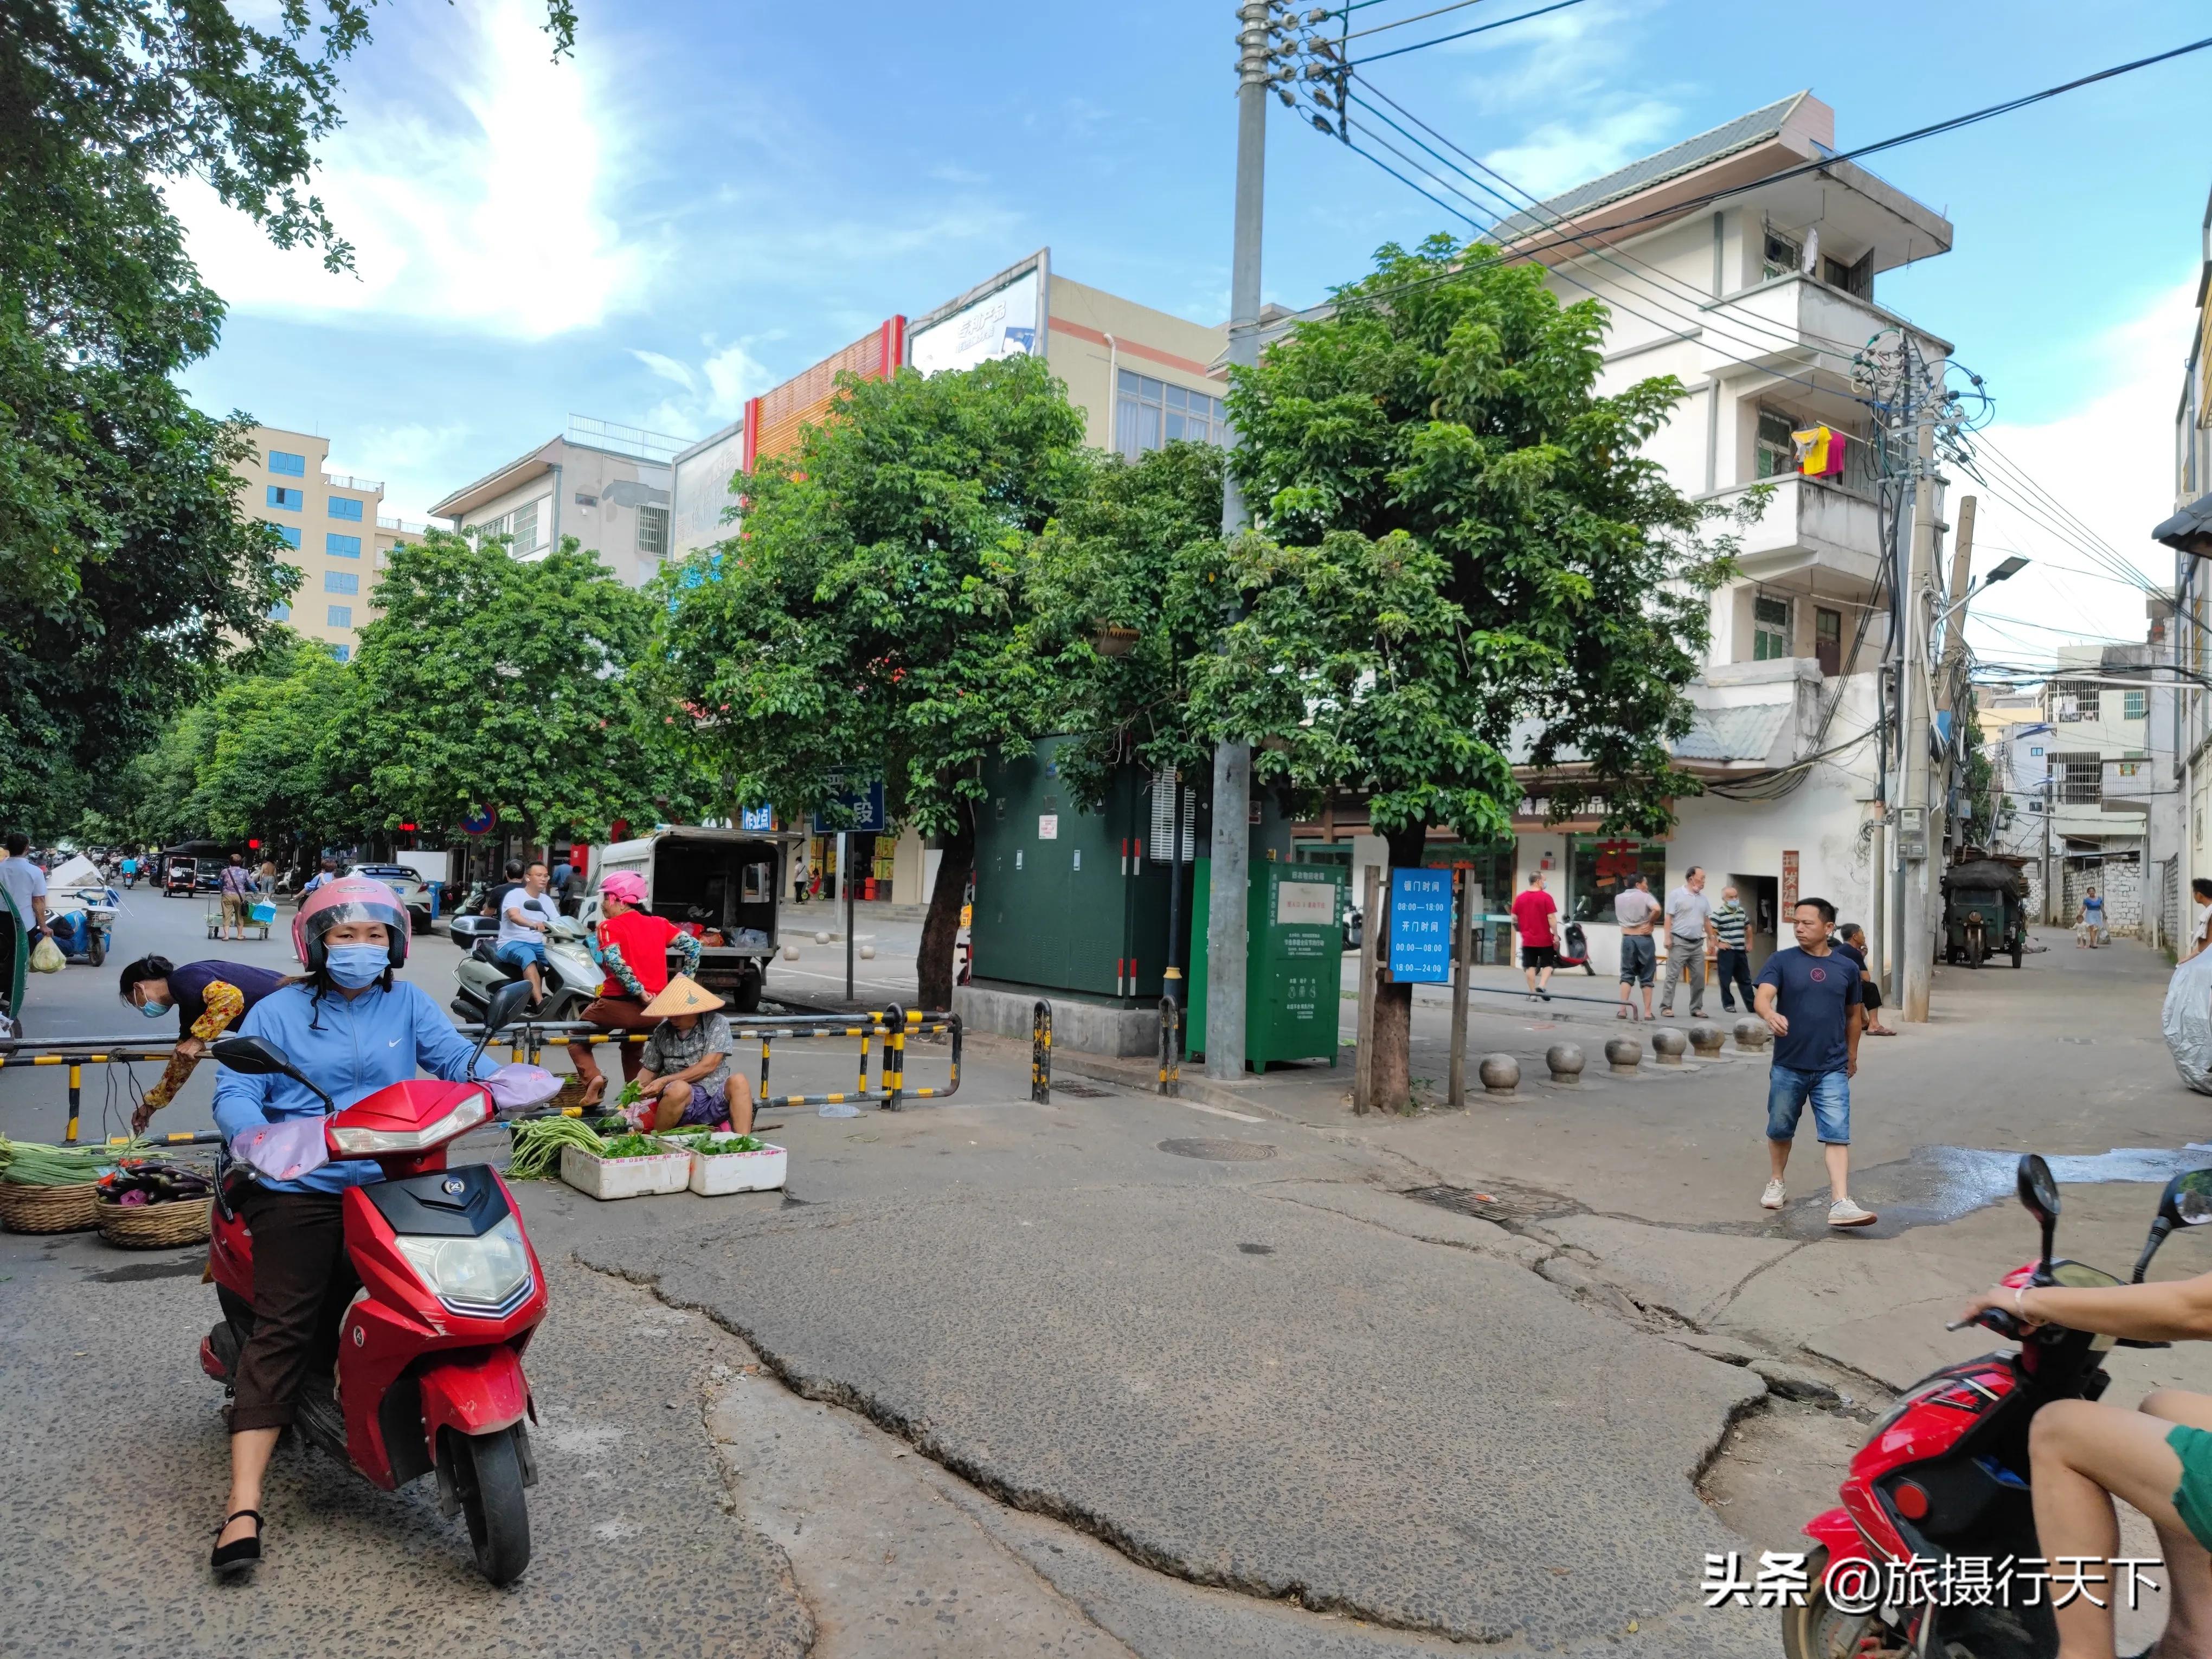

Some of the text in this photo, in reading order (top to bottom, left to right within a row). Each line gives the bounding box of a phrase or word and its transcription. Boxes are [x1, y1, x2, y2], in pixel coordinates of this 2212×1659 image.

[746, 809, 768, 829] 作业点
[1404, 880, 1439, 892] 锁门时间
[1401, 921, 1438, 933] 开门时间
